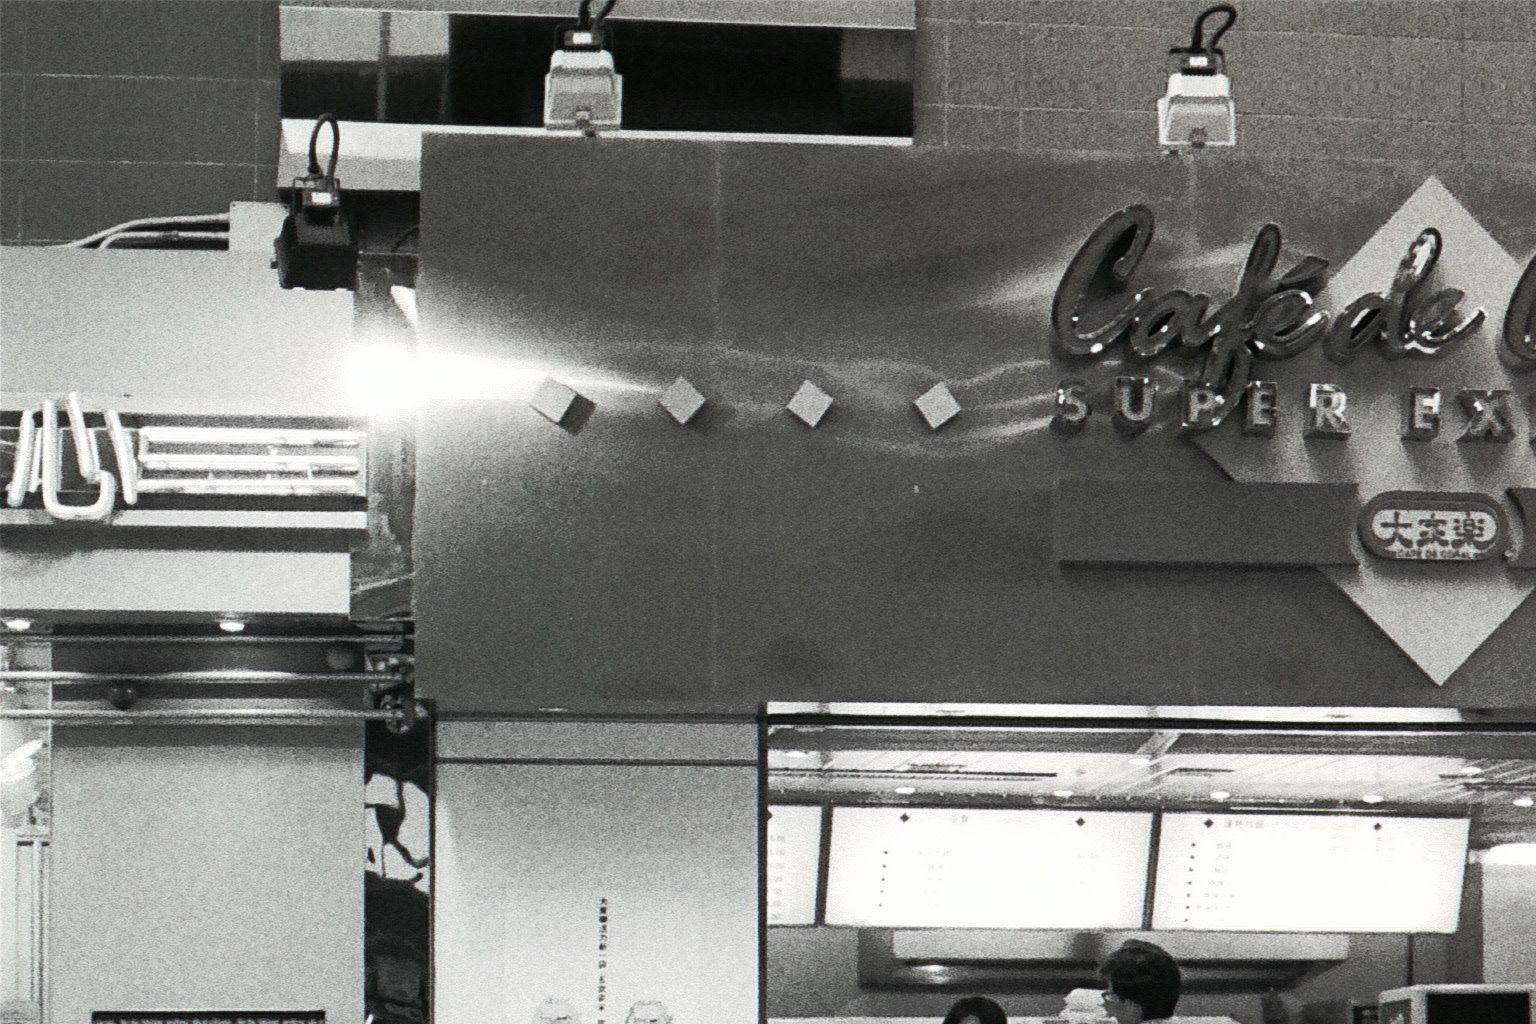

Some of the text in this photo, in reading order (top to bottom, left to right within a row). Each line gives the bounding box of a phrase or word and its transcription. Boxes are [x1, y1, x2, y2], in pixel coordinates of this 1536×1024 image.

[1050, 204, 1330, 426] Café
[1323, 226, 1485, 360] de
[1055, 374, 1350, 434] SUPER
